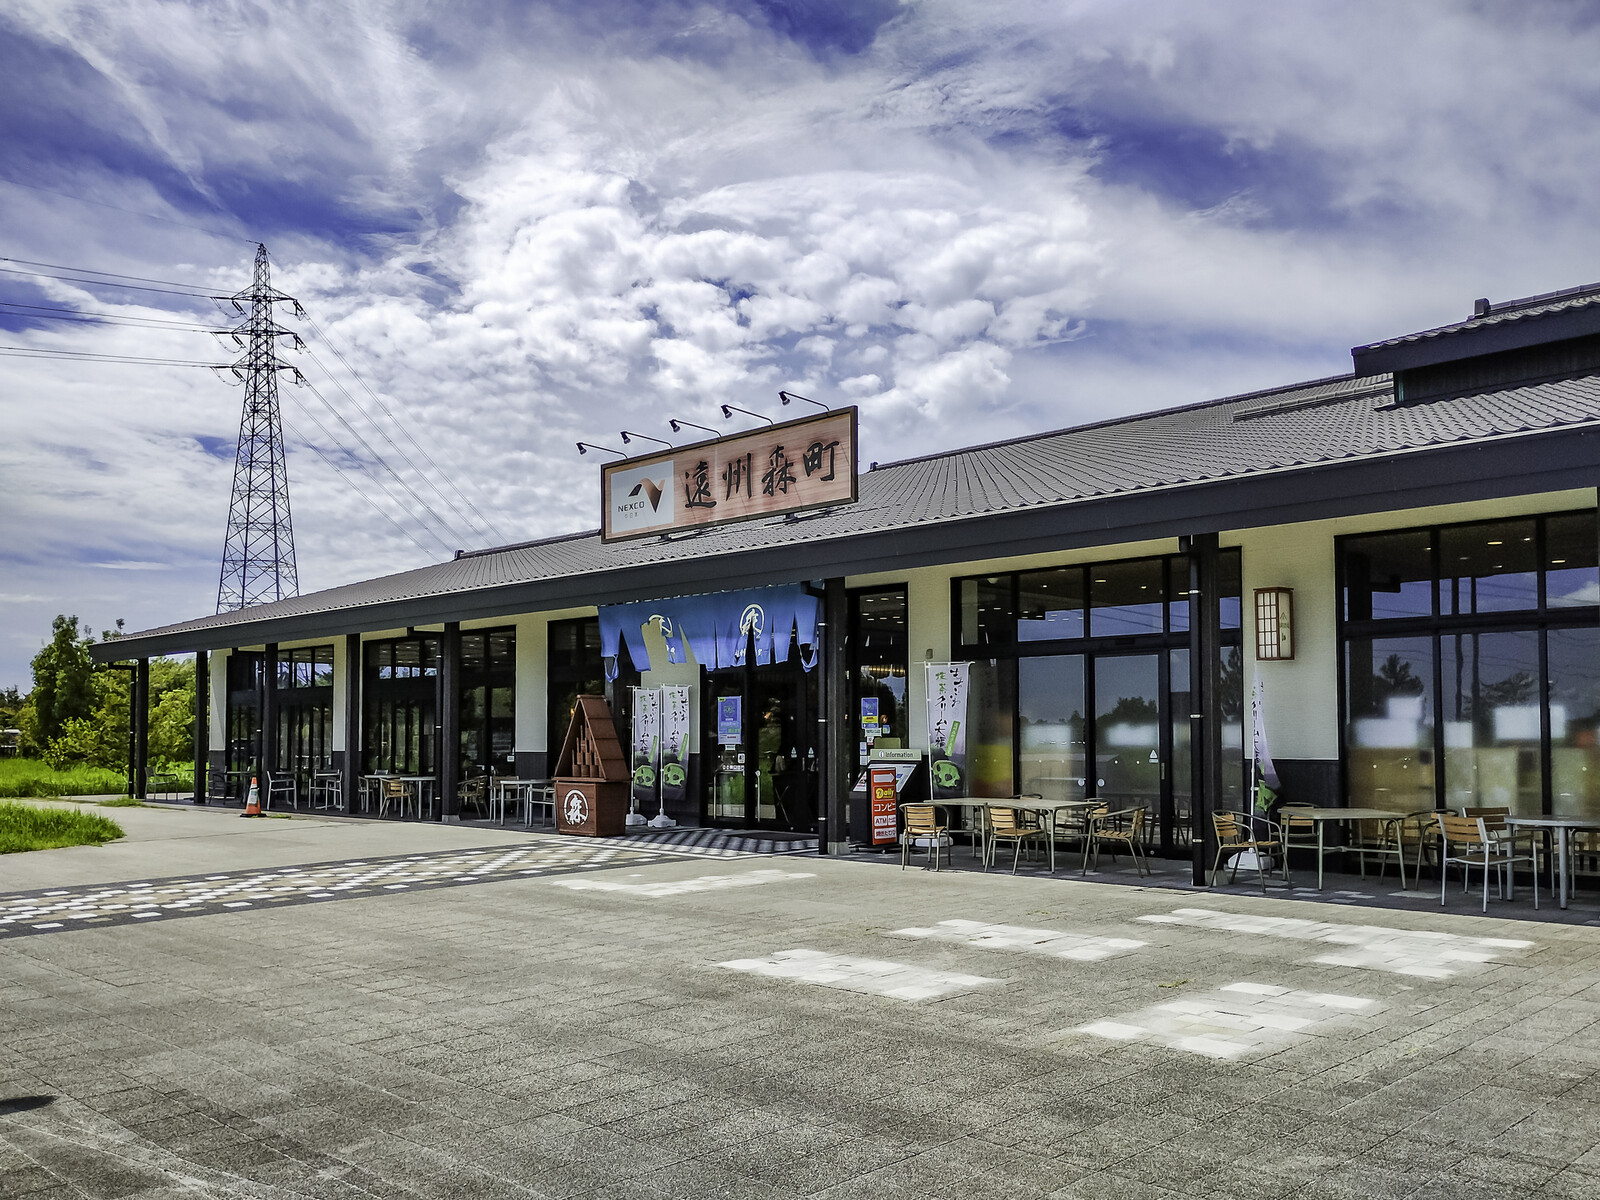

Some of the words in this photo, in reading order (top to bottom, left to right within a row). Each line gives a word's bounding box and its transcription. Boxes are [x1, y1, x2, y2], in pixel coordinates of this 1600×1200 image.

[684, 440, 840, 509] 遠州森町
[617, 501, 645, 512] NEXCO
